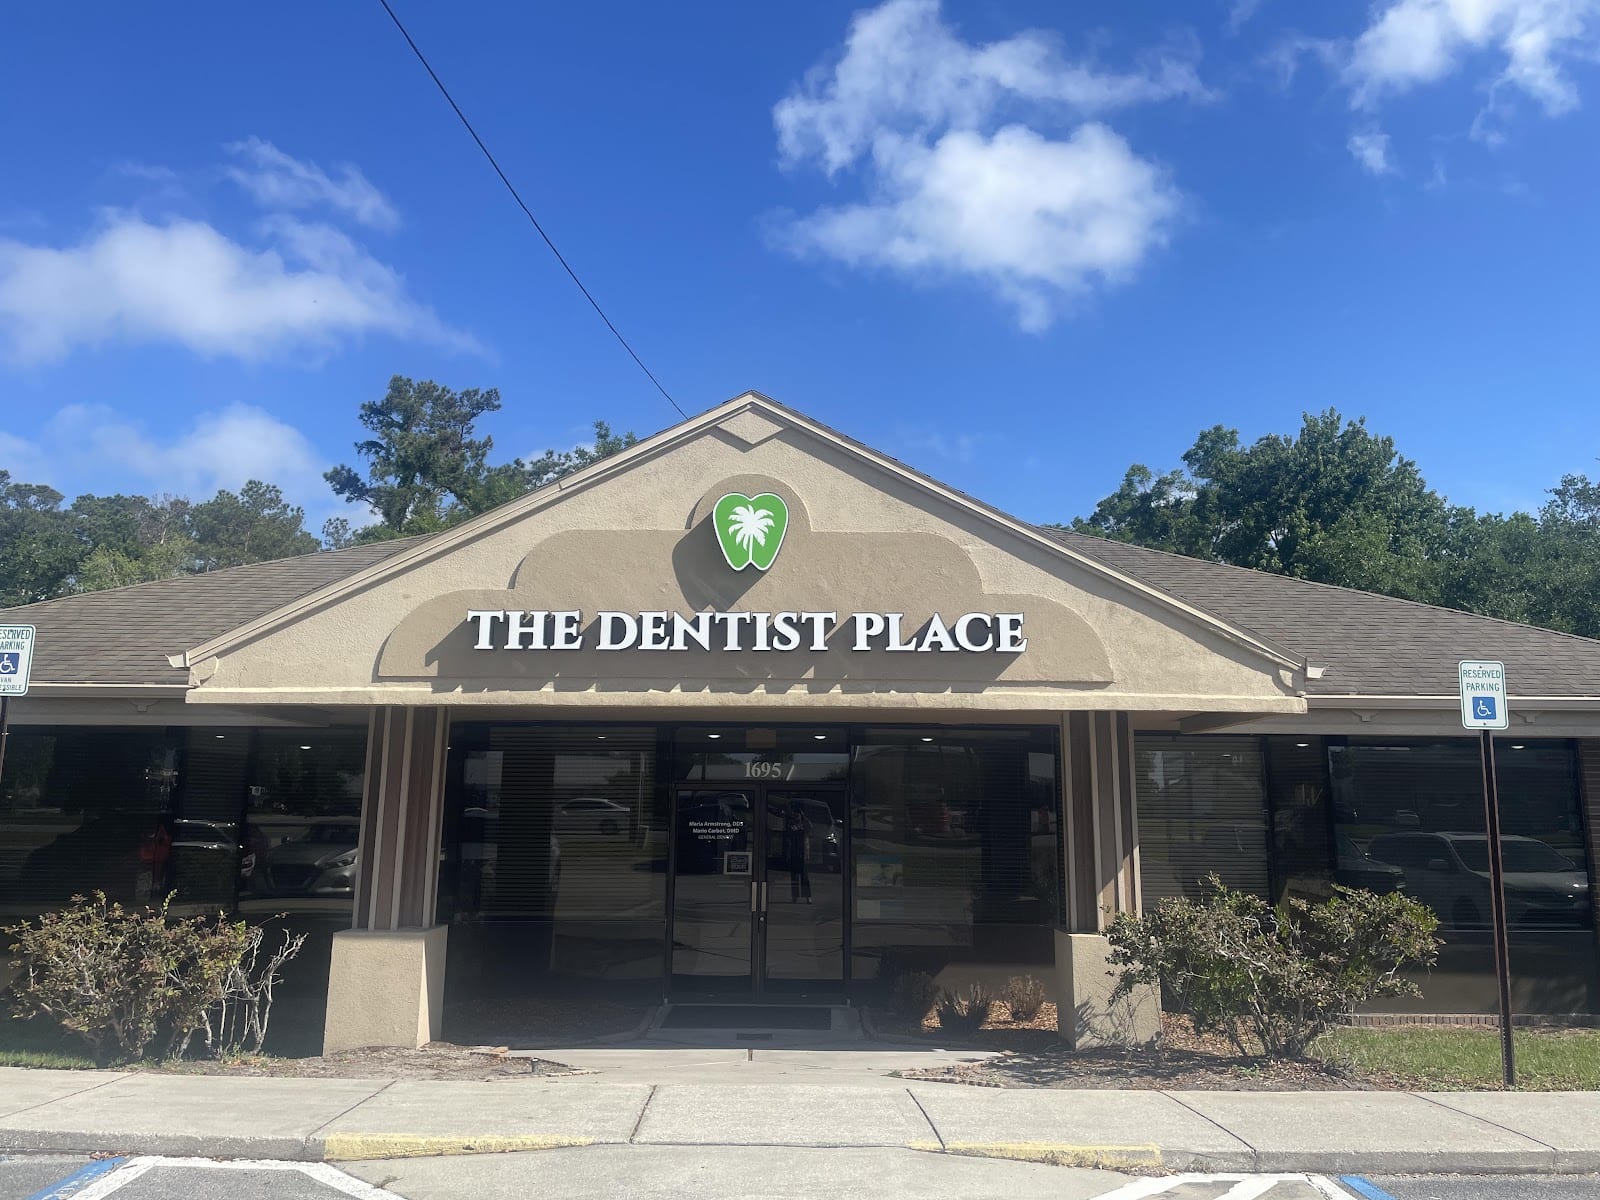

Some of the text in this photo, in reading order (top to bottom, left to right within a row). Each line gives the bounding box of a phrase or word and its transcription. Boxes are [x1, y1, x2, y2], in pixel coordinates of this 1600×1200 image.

[0, 629, 30, 639] SERVED
[467, 609, 1028, 654] THE DENTIST PLACE
[0, 641, 25, 650] ARKING
[1463, 669, 1501, 679] RESERVED
[1466, 682, 1500, 692] PARKING
